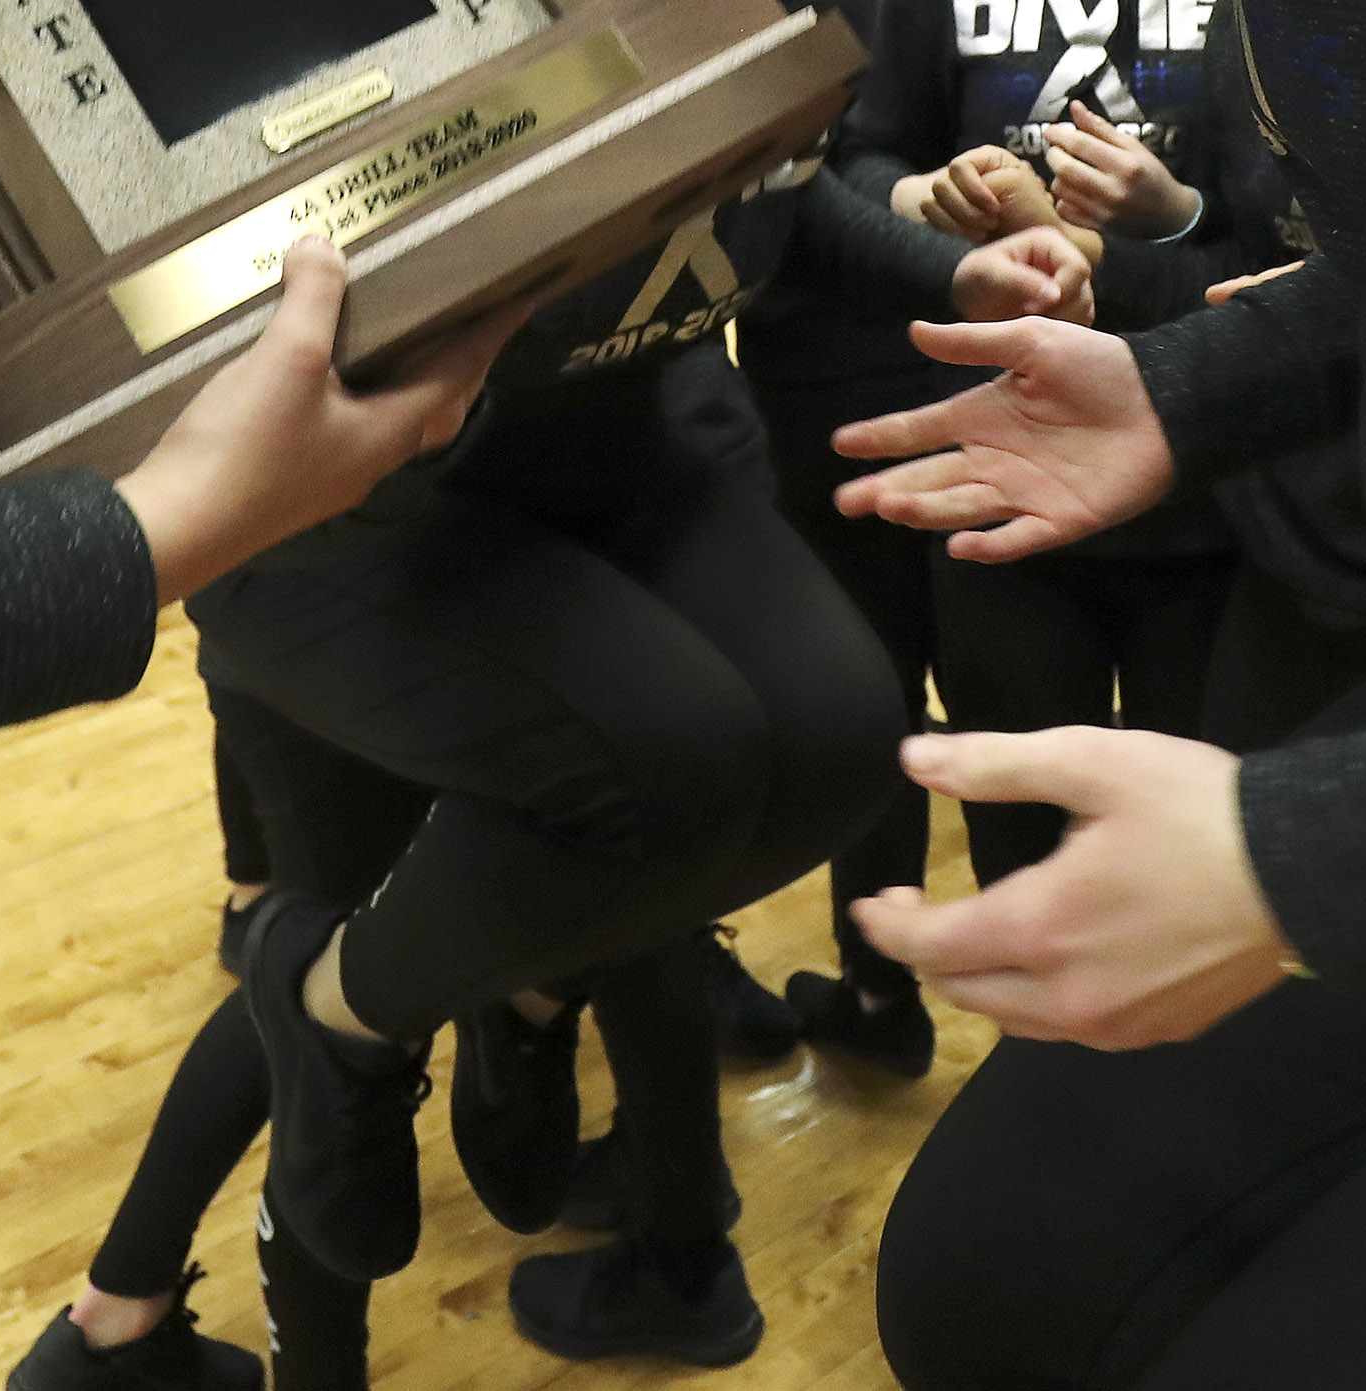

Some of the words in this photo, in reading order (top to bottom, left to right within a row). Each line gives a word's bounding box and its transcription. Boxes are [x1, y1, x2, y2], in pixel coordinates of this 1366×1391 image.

[325, 151, 407, 206] DRILL
[404, 107, 480, 160] TEAM
[363, 170, 431, 214] Place
